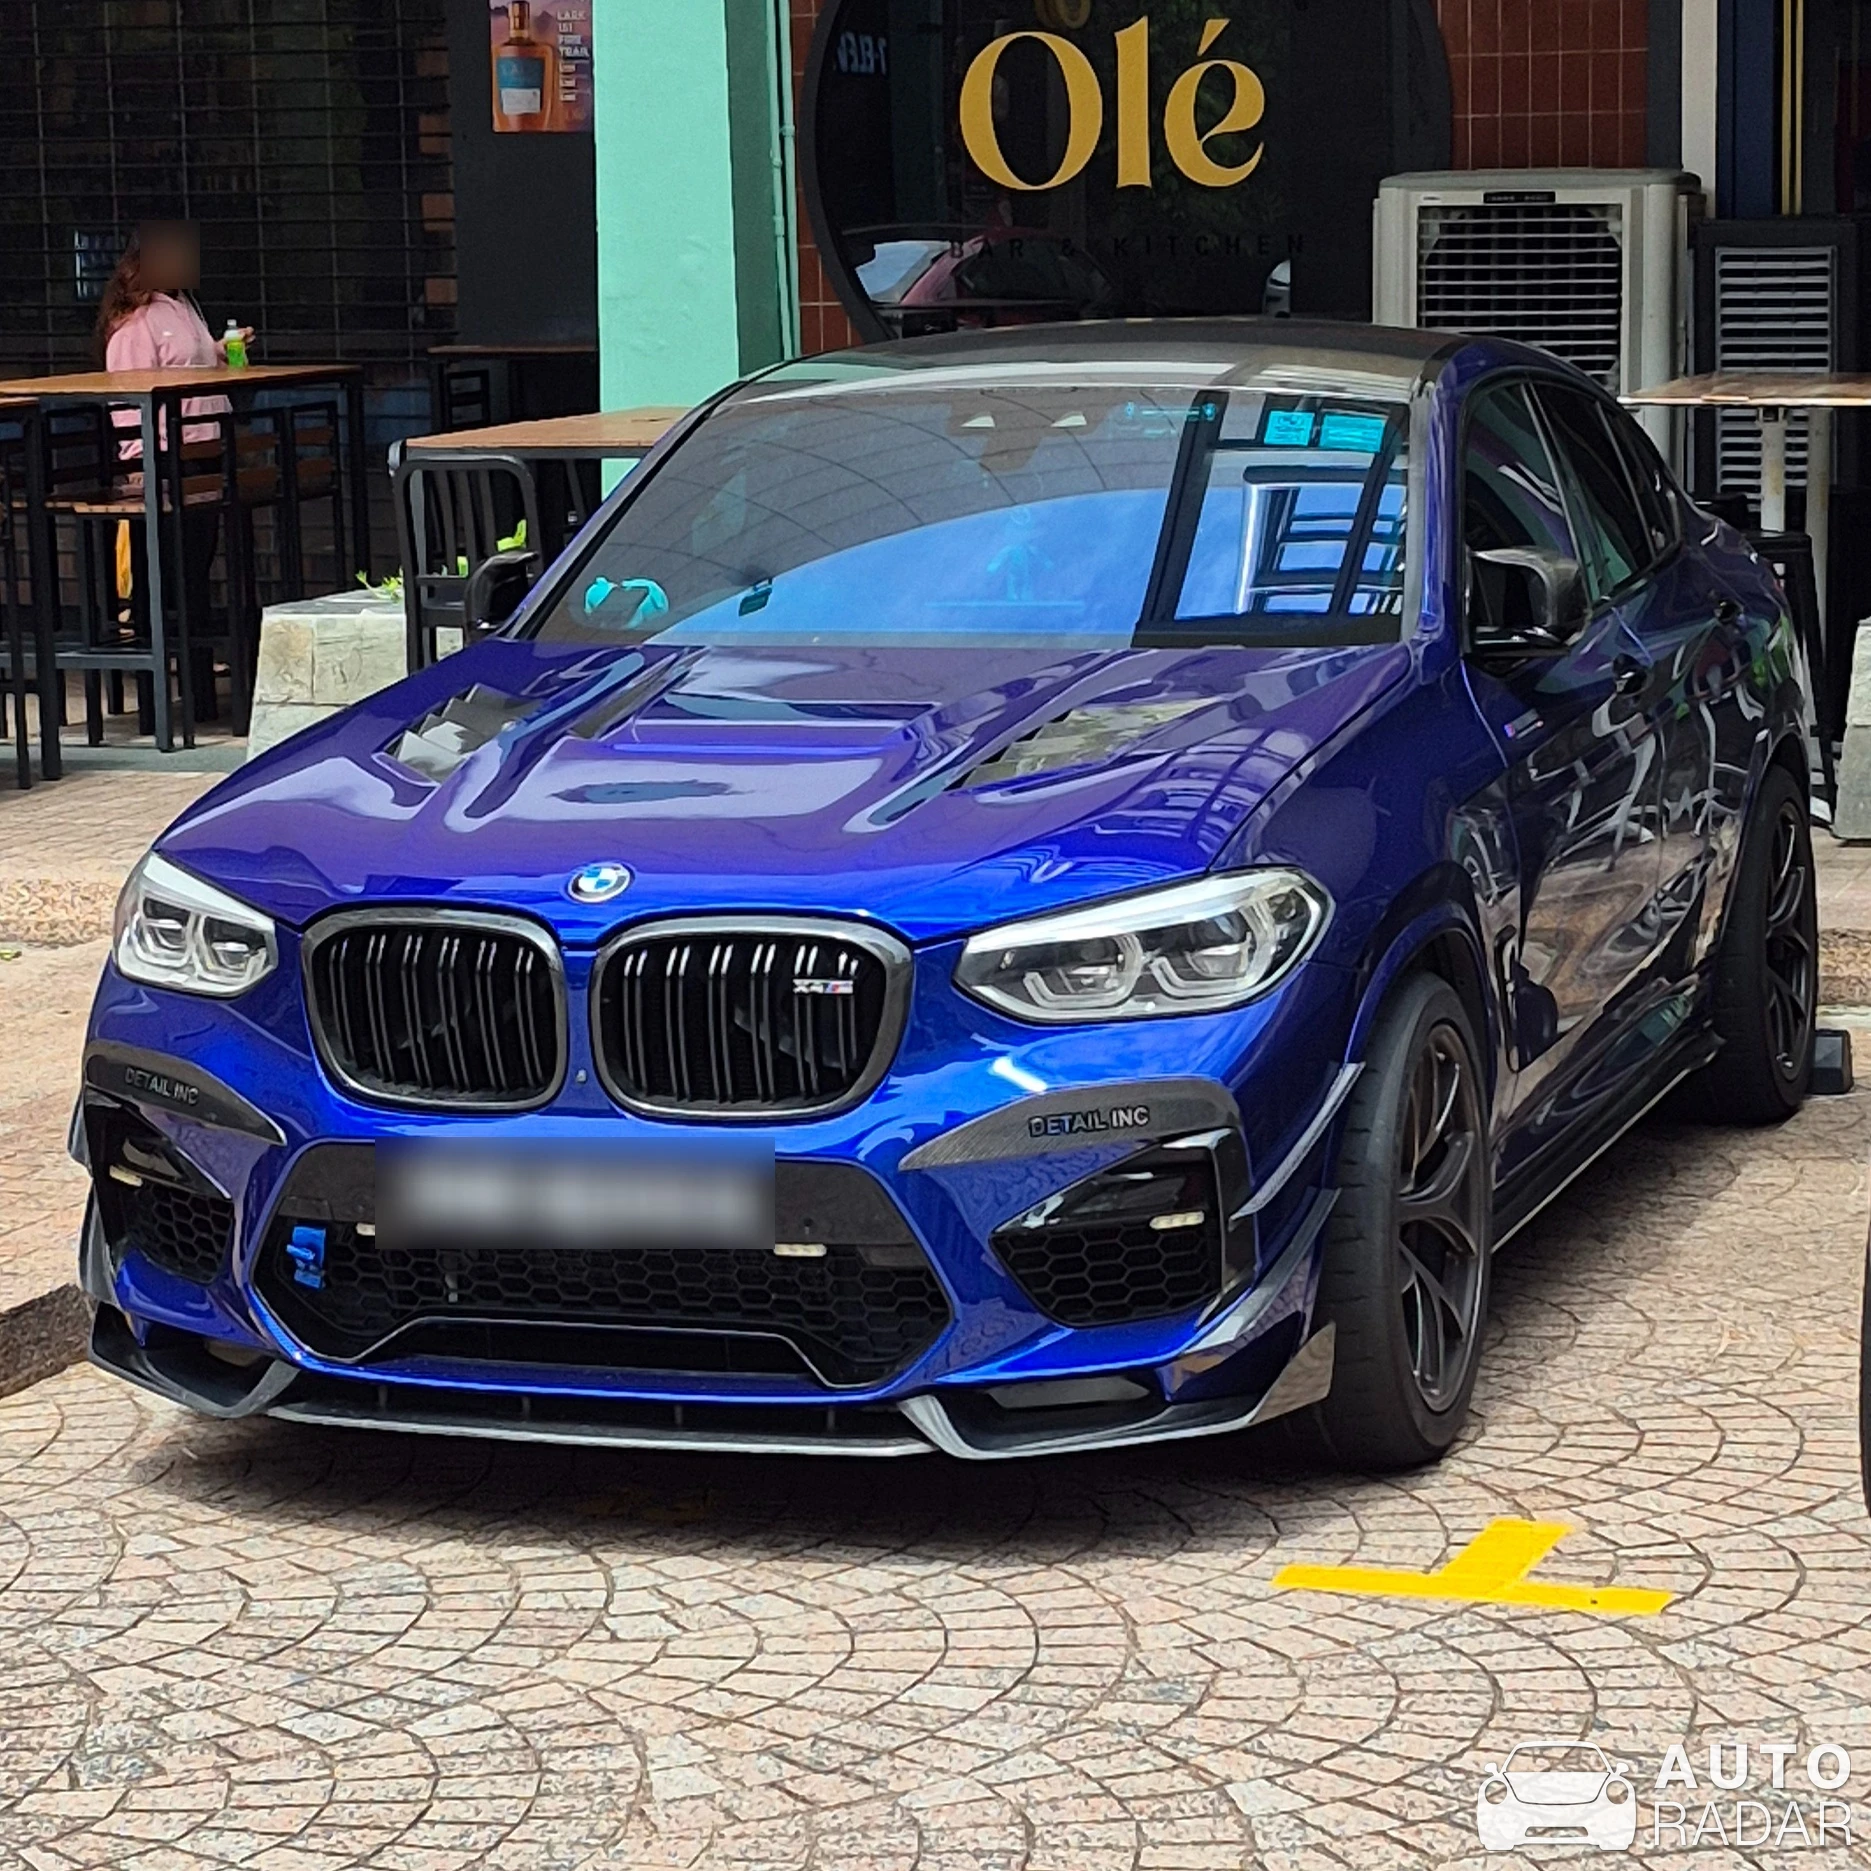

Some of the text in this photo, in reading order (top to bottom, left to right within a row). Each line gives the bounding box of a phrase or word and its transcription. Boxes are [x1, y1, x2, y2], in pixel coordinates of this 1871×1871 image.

[959, 15, 1265, 191] Olé
[949, 234, 1306, 259] BAR & KITCHEN
[1028, 1105, 1150, 1137] DETAIL INC
